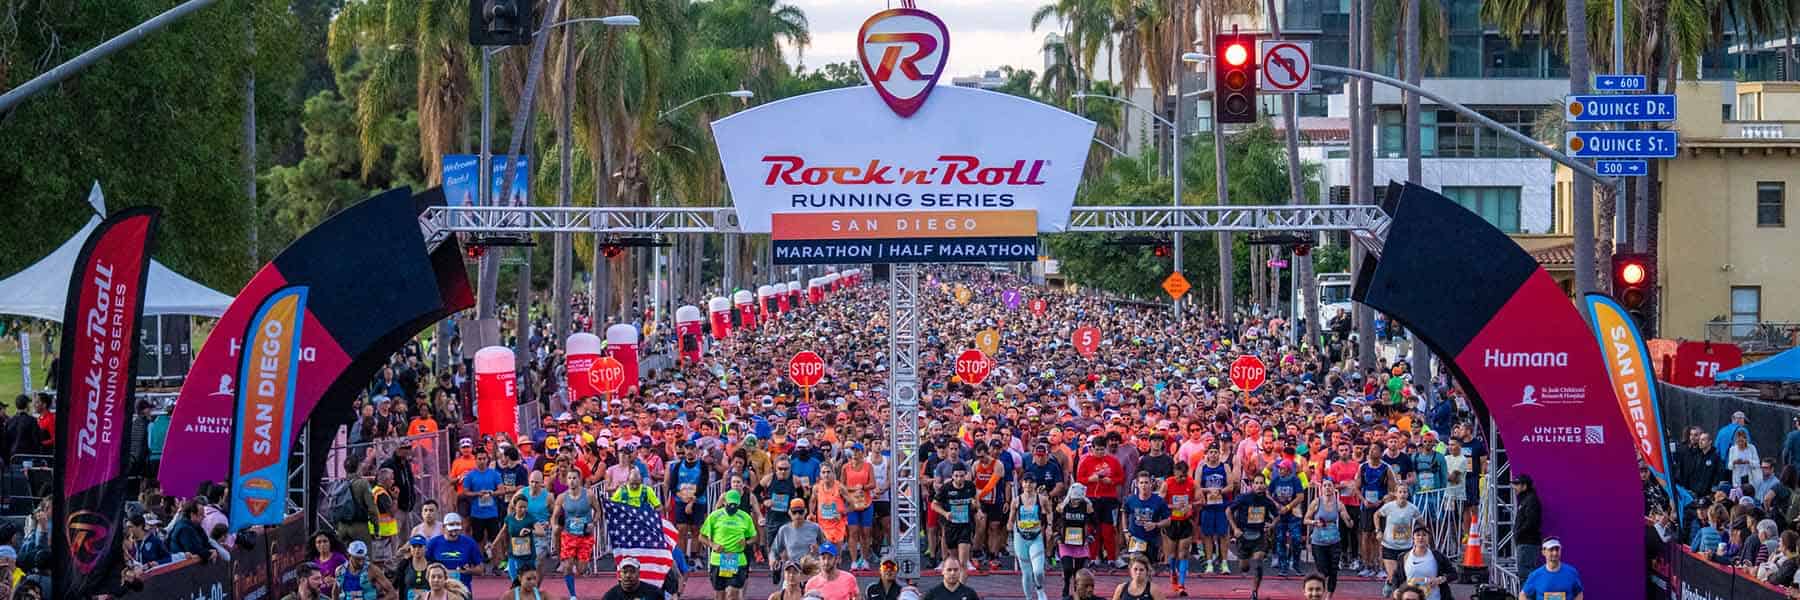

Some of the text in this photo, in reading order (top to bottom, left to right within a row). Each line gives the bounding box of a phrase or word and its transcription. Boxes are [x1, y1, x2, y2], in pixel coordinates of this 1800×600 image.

[1619, 78, 1639, 88] 600
[1587, 100, 1670, 116] QUINCE DR.
[1589, 136, 1669, 152] QUINCE ST.
[1604, 163, 1623, 173] 500
[792, 193, 1014, 208] RUNNING SERIES
[831, 218, 977, 232] SAN DIEGO
[776, 243, 1036, 259] MARATHON HALF MARATHON
[1008, 292, 1016, 302] 7
[983, 333, 992, 346] 6
[1082, 331, 1093, 346] 5
[102, 283, 126, 444] RUNNING SERIES
[1484, 349, 1568, 368] Humana
[791, 362, 823, 377] STOP
[958, 360, 987, 373] STOP
[1231, 365, 1264, 380] STOP
[592, 367, 621, 383] STOP
[253, 319, 283, 456] SAN DIEGO
[505, 380, 514, 397] E
[1611, 325, 1652, 455] SAN DIEGO
[1534, 426, 1581, 434] UNITED
[1521, 435, 1581, 443] AIRLINES
